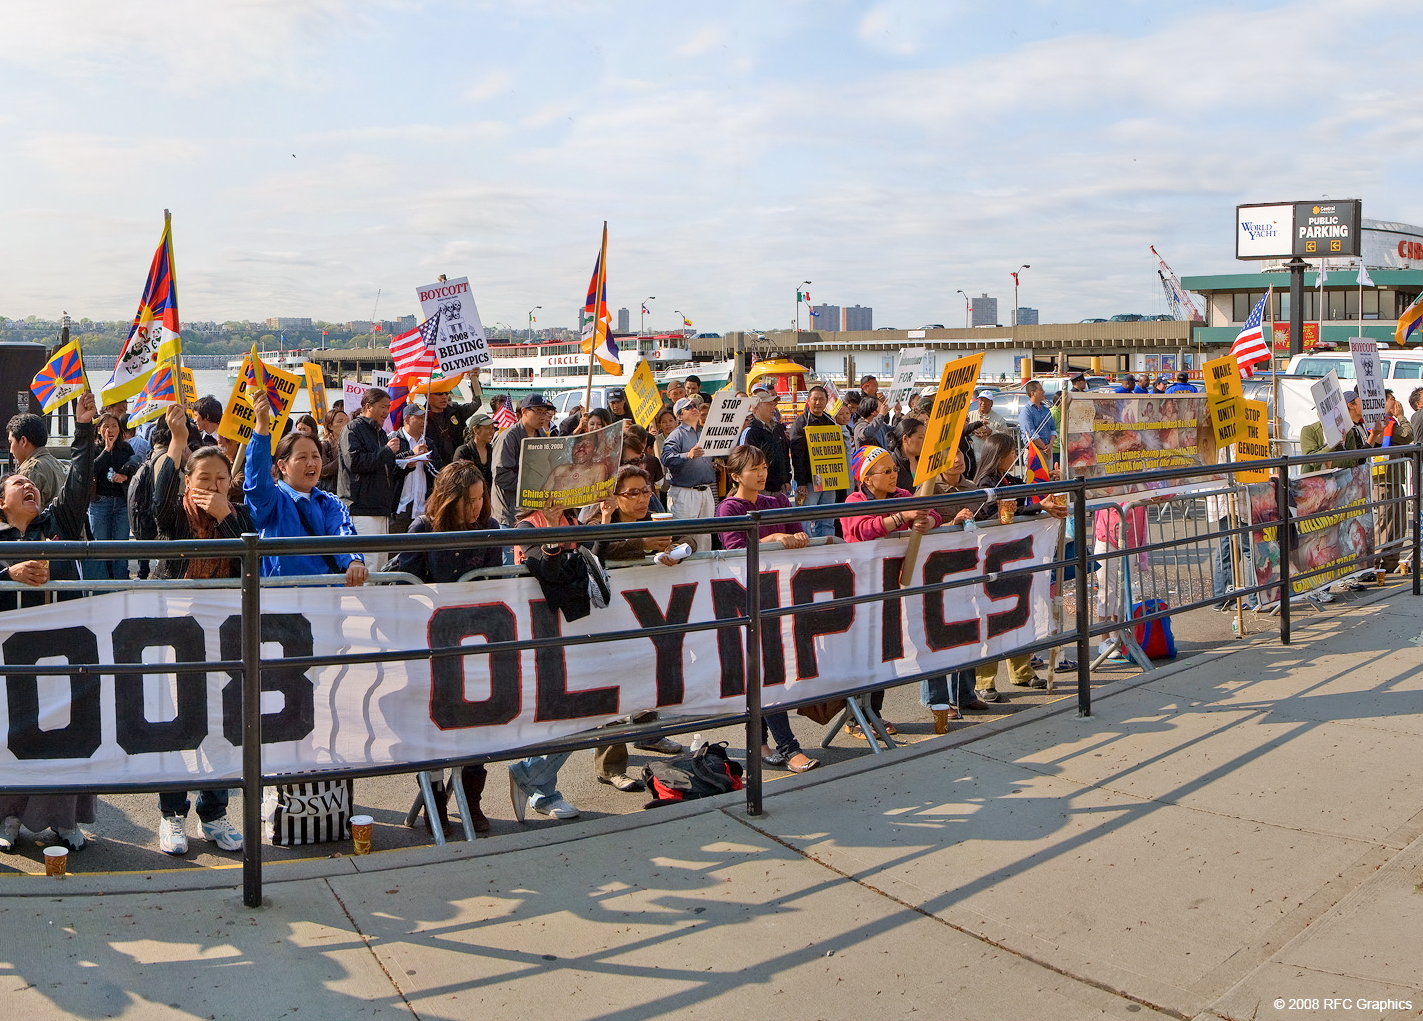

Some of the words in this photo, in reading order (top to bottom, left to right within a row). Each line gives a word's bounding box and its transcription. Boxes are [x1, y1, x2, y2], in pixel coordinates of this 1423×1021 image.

[1241, 222, 1273, 231] WORLD
[1308, 216, 1338, 225] PUBLIC
[1249, 230, 1278, 240] YACHT
[1299, 225, 1348, 238] PARKING
[419, 282, 469, 302] BOYCOTT
[449, 331, 469, 343] 2008
[438, 338, 484, 359] BEIJING
[1351, 342, 1377, 353] BOYCOTT
[441, 352, 490, 373] OLYMPICS
[548, 356, 578, 365] CIRCLE
[898, 372, 913, 383] FOR
[944, 363, 977, 391] HUMAN
[1212, 363, 1232, 380] WAKE
[632, 373, 644, 392] STOP
[1220, 382, 1230, 396] UP
[889, 388, 912, 403] TIBET
[1367, 389, 1378, 397] 2008
[635, 386, 657, 418] GENOCIDE
[645, 398, 658, 418] TIBET
[721, 400, 741, 409] STOP
[936, 391, 969, 419] RIGHTS
[1362, 399, 1385, 410] BEIJING
[232, 403, 254, 421] FREE
[721, 413, 735, 422] THE
[1245, 407, 1260, 422] STOP
[1363, 413, 1386, 424] OLYMPICS
[237, 424, 252, 439] NO
[706, 426, 739, 436] KILLINGS
[810, 433, 820, 442] ONE
[821, 432, 840, 441] WORLD
[940, 422, 951, 443] IN
[1248, 425, 1259, 438] THE
[703, 440, 713, 449] IN
[714, 439, 734, 449] TIBET
[812, 447, 822, 456] ONE
[823, 445, 843, 455] DREAM
[1238, 441, 1268, 457] GENOCIDE
[926, 447, 951, 474] TIBET
[1116, 461, 1133, 473] CHINA
[815, 464, 829, 474] FREE
[830, 463, 844, 472] TIBET
[824, 477, 838, 487] NOW
[522, 489, 549, 499] China's
[550, 486, 582, 499] response
[564, 494, 593, 506] FREEDOM
[428, 535, 1035, 731] OLYMPICS
[286, 787, 345, 816] DSW
